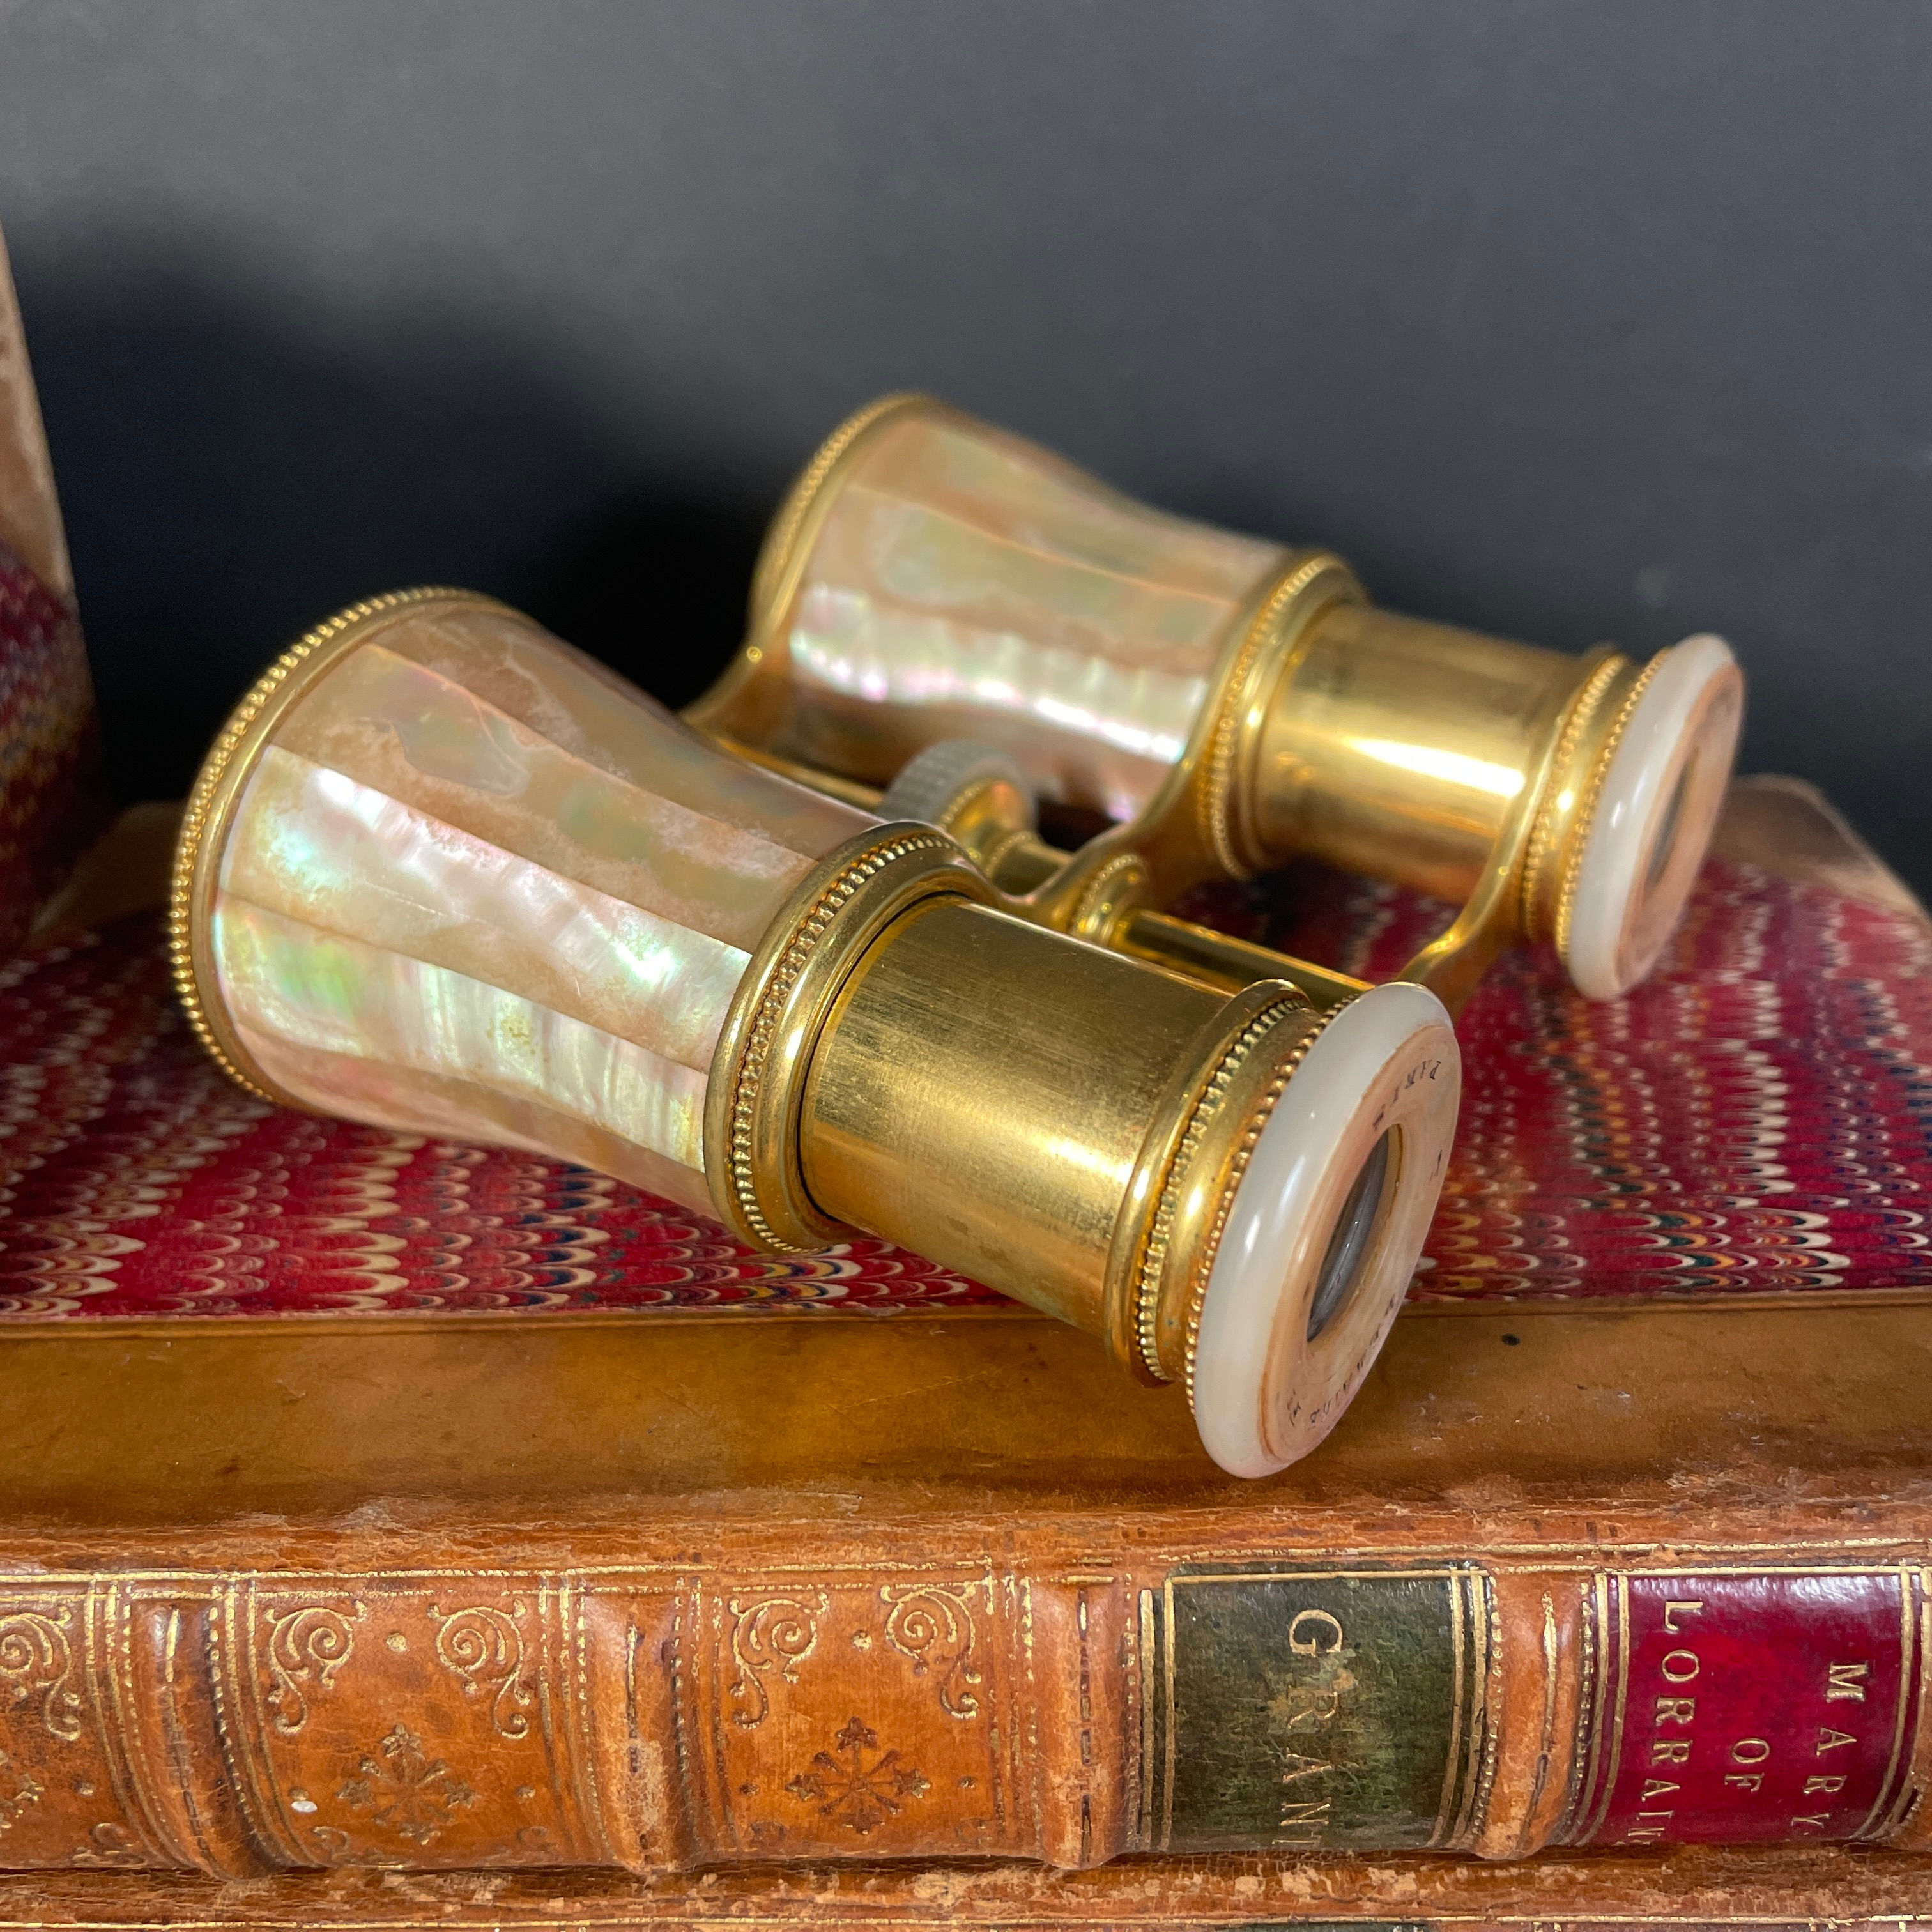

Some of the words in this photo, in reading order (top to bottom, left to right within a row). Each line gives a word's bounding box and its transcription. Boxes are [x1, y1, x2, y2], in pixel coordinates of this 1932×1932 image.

[1625, 1598, 1703, 1846] LORRAIN
[1724, 1738, 1770, 1792] OF
[1791, 1660, 1869, 1828] MARY
